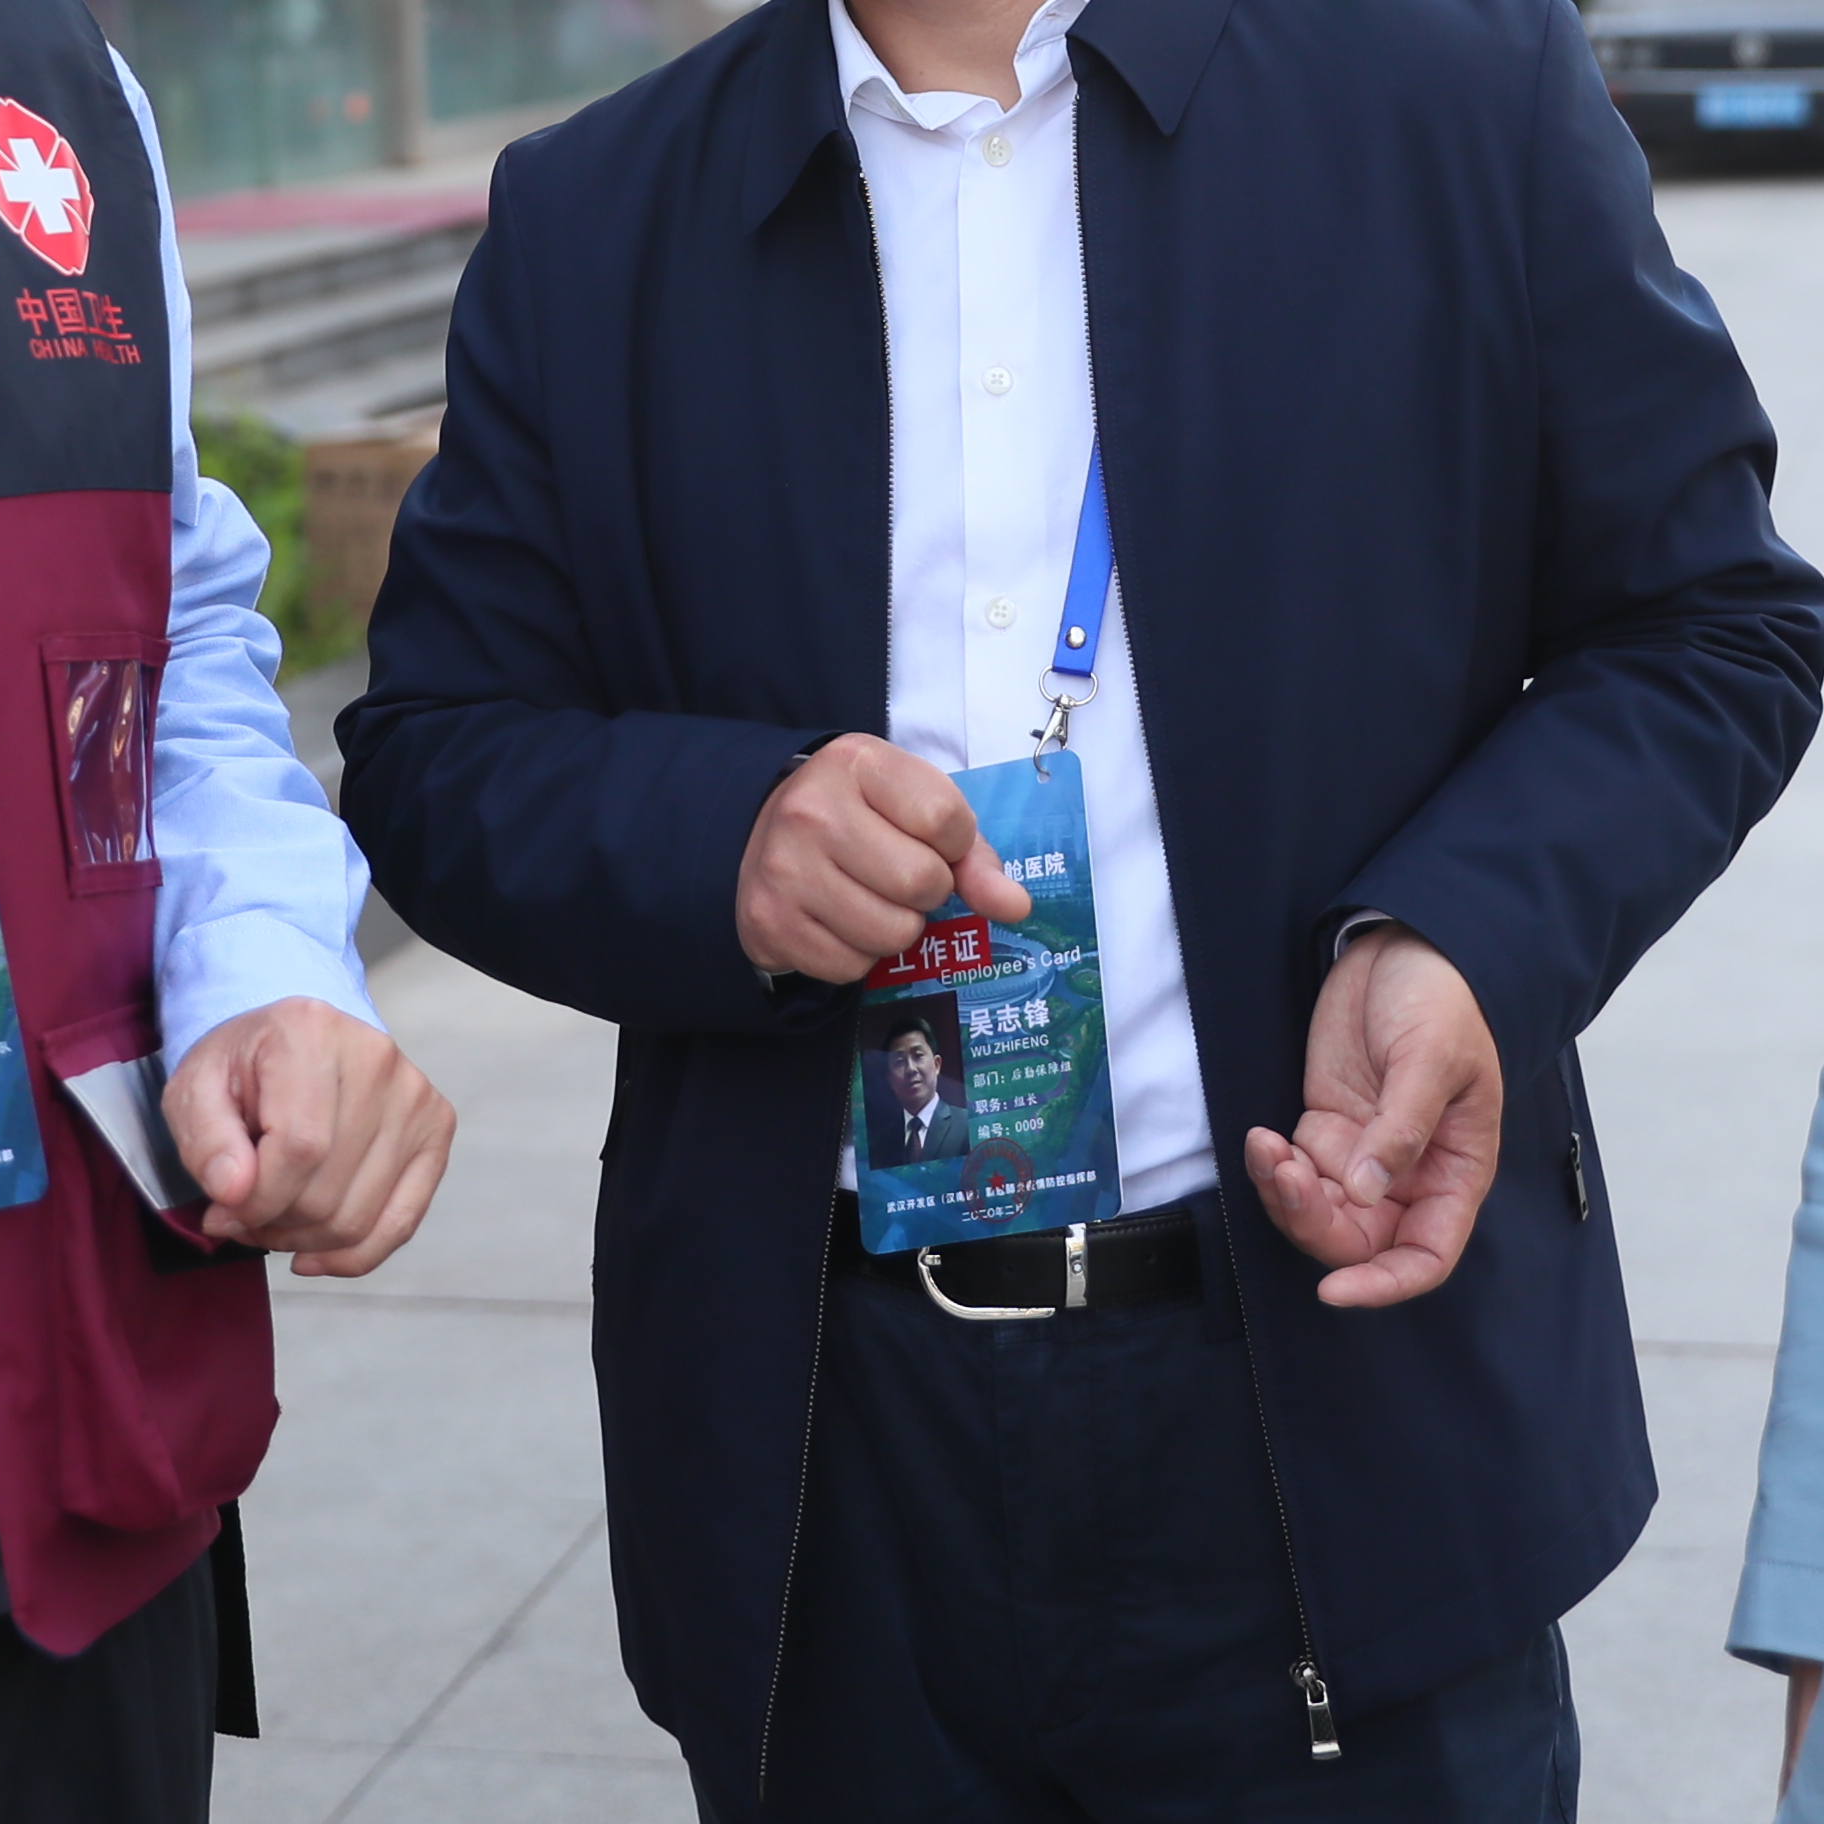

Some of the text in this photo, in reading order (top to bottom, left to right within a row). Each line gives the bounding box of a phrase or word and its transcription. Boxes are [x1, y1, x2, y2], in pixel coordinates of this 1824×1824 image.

[29, 337, 88, 360] CHINA
[940, 946, 1081, 986] Employee's Card
[969, 998, 1051, 1039] 吴志锋
[970, 1034, 1050, 1058] WU ZHIFENG
